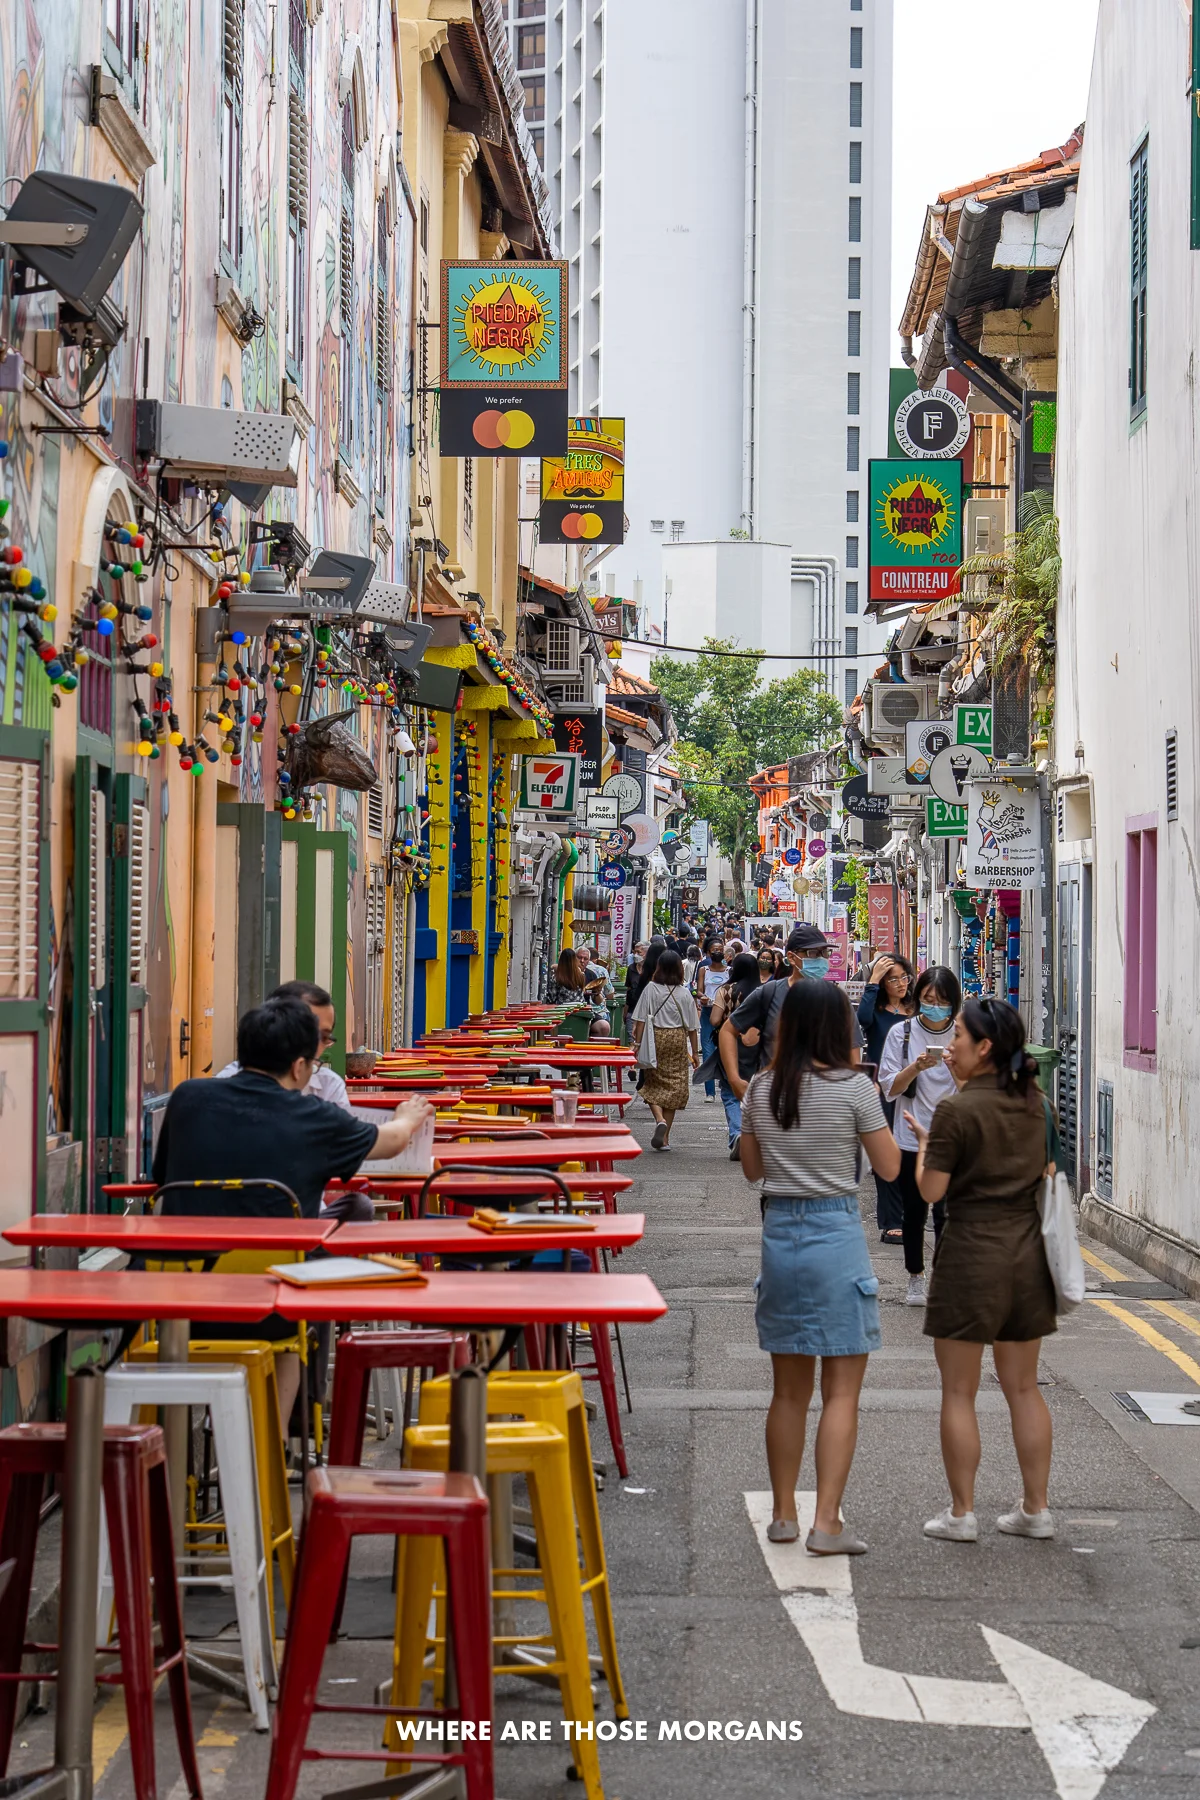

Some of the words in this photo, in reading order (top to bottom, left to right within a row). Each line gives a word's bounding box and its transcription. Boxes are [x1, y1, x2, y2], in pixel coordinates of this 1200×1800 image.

[472, 303, 541, 324] PIEDRA
[473, 327, 535, 349] NEGRA
[484, 396, 498, 404] We
[499, 396, 523, 406] prefer
[896, 395, 920, 423] PIZZA
[921, 389, 967, 421] FABBRICA
[923, 411, 943, 440] F
[896, 429, 919, 458] PIZZA
[922, 430, 968, 459] FABBRICA
[563, 452, 604, 471] TRES
[551, 468, 614, 490] AMIGOS
[890, 497, 944, 513] PIEDRA
[891, 517, 940, 533] NEGRA
[931, 552, 958, 564] TOO
[881, 571, 949, 589] COINTREAU
[595, 614, 617, 632] yl's
[964, 711, 990, 736] EX
[848, 795, 888, 809] PASH
[974, 865, 1036, 877] BARBERSHOP
[988, 878, 1022, 887] #02-02
[613, 894, 625, 931] Studio
[579, 923, 605, 933] Vino
[877, 915, 889, 953] PIN
[614, 933, 625, 959] Lash
